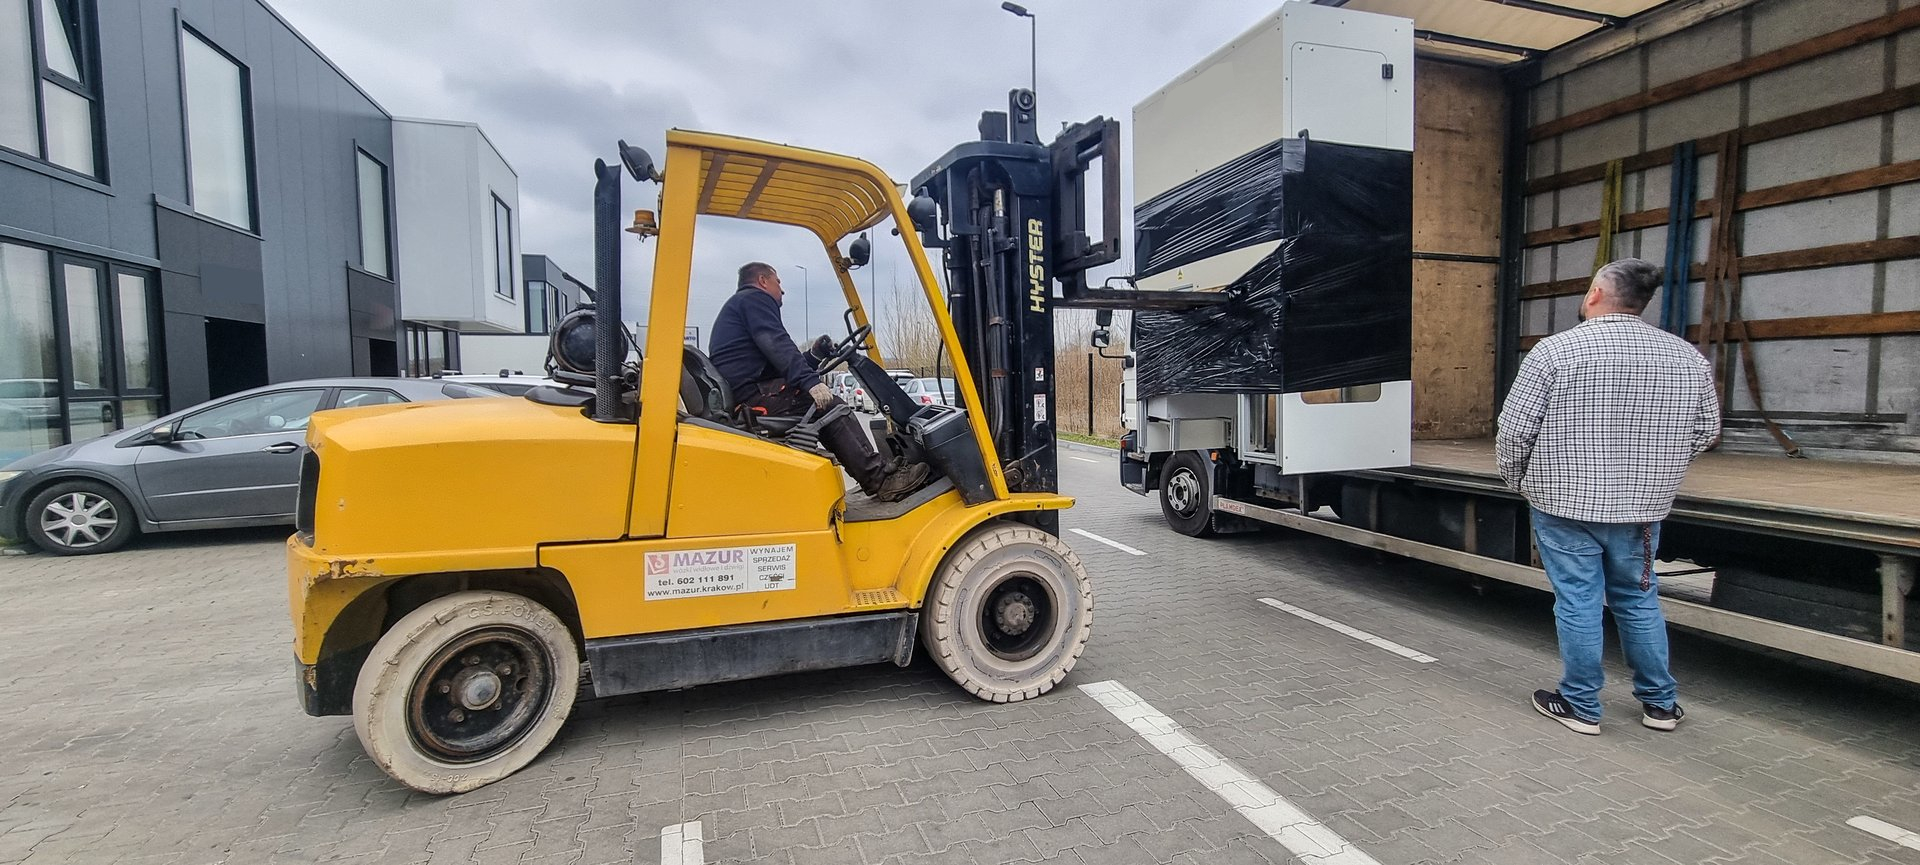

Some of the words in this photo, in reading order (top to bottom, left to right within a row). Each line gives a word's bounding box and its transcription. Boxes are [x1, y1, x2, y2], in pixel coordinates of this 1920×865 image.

[1028, 218, 1045, 313] HYSTER
[750, 546, 794, 555] WYNAJEM
[673, 550, 744, 567] MAZUR
[757, 564, 786, 572] SERWIS
[658, 578, 674, 587] tel.
[677, 577, 695, 585] 602
[698, 575, 714, 583] 111
[717, 574, 734, 582] 891
[647, 582, 744, 597] www.mazur.krakow.pl
